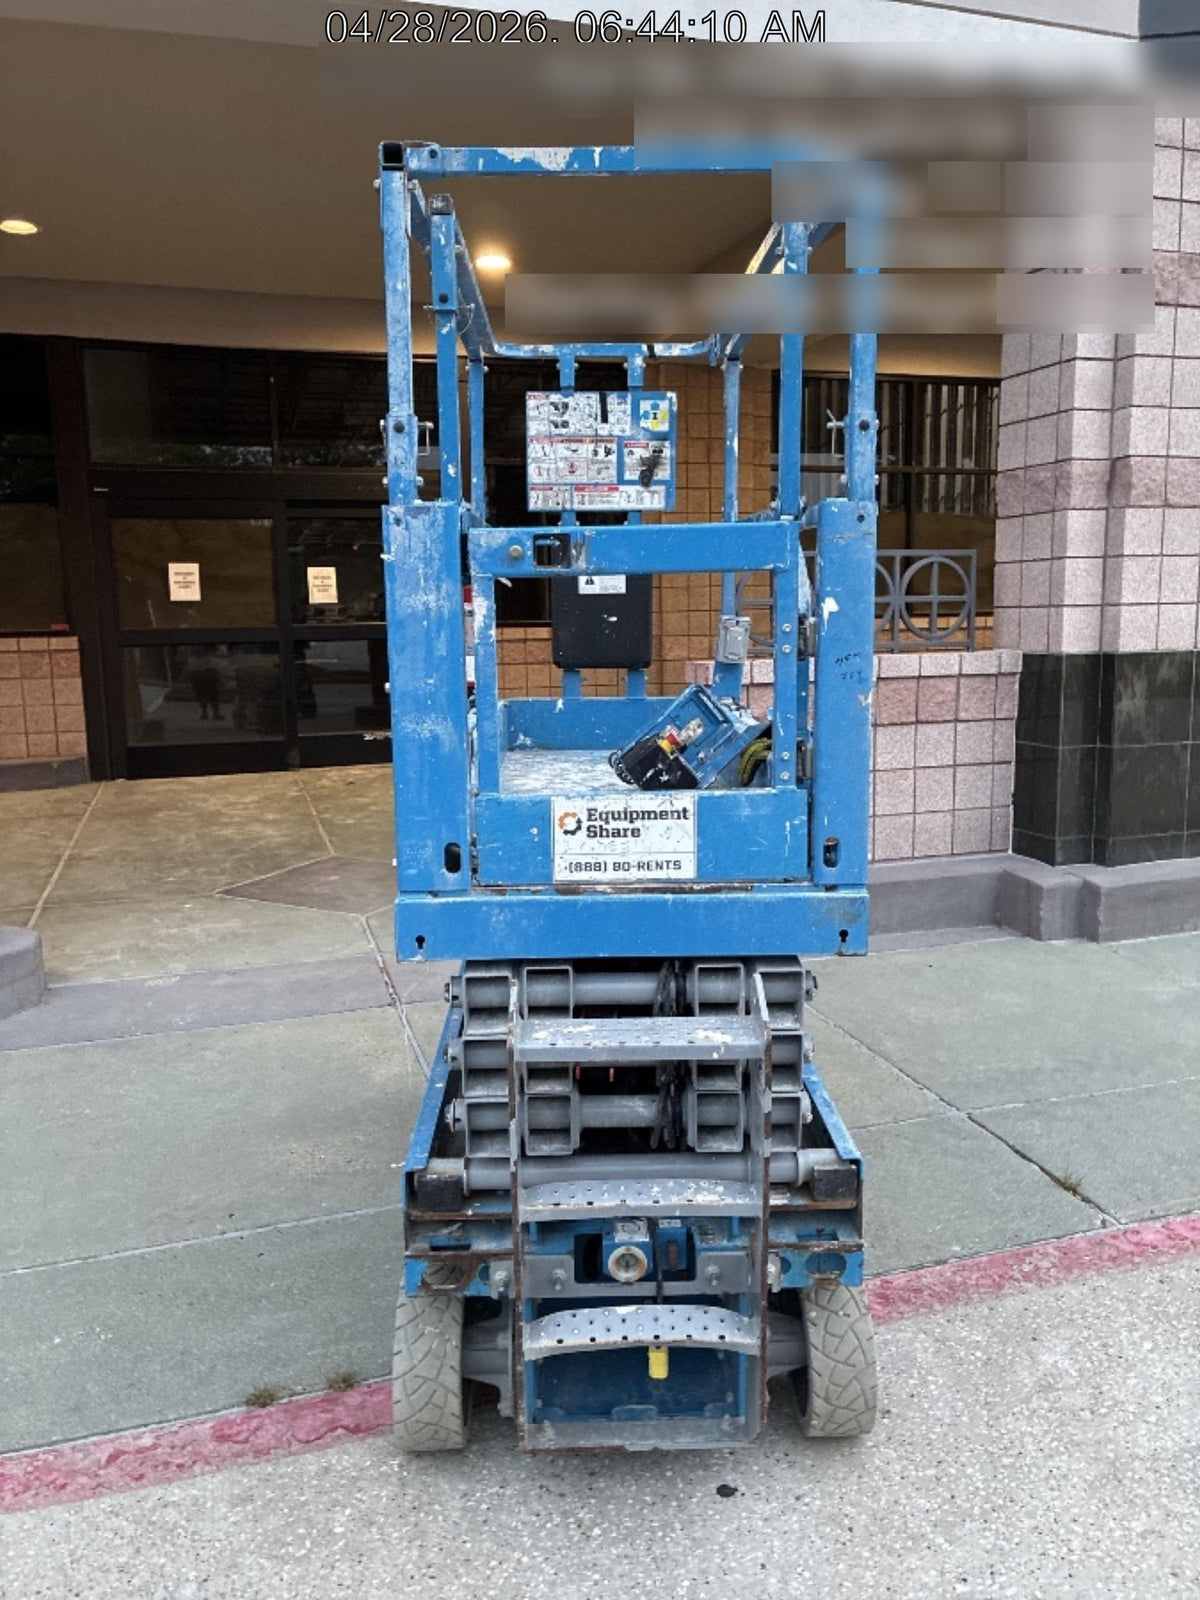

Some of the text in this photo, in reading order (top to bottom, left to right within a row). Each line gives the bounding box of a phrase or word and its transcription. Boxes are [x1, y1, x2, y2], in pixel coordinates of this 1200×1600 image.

[586, 807, 689, 824] Equipment
[586, 825, 641, 838] Share
[569, 860, 682, 872] (888) 80-RENTS
